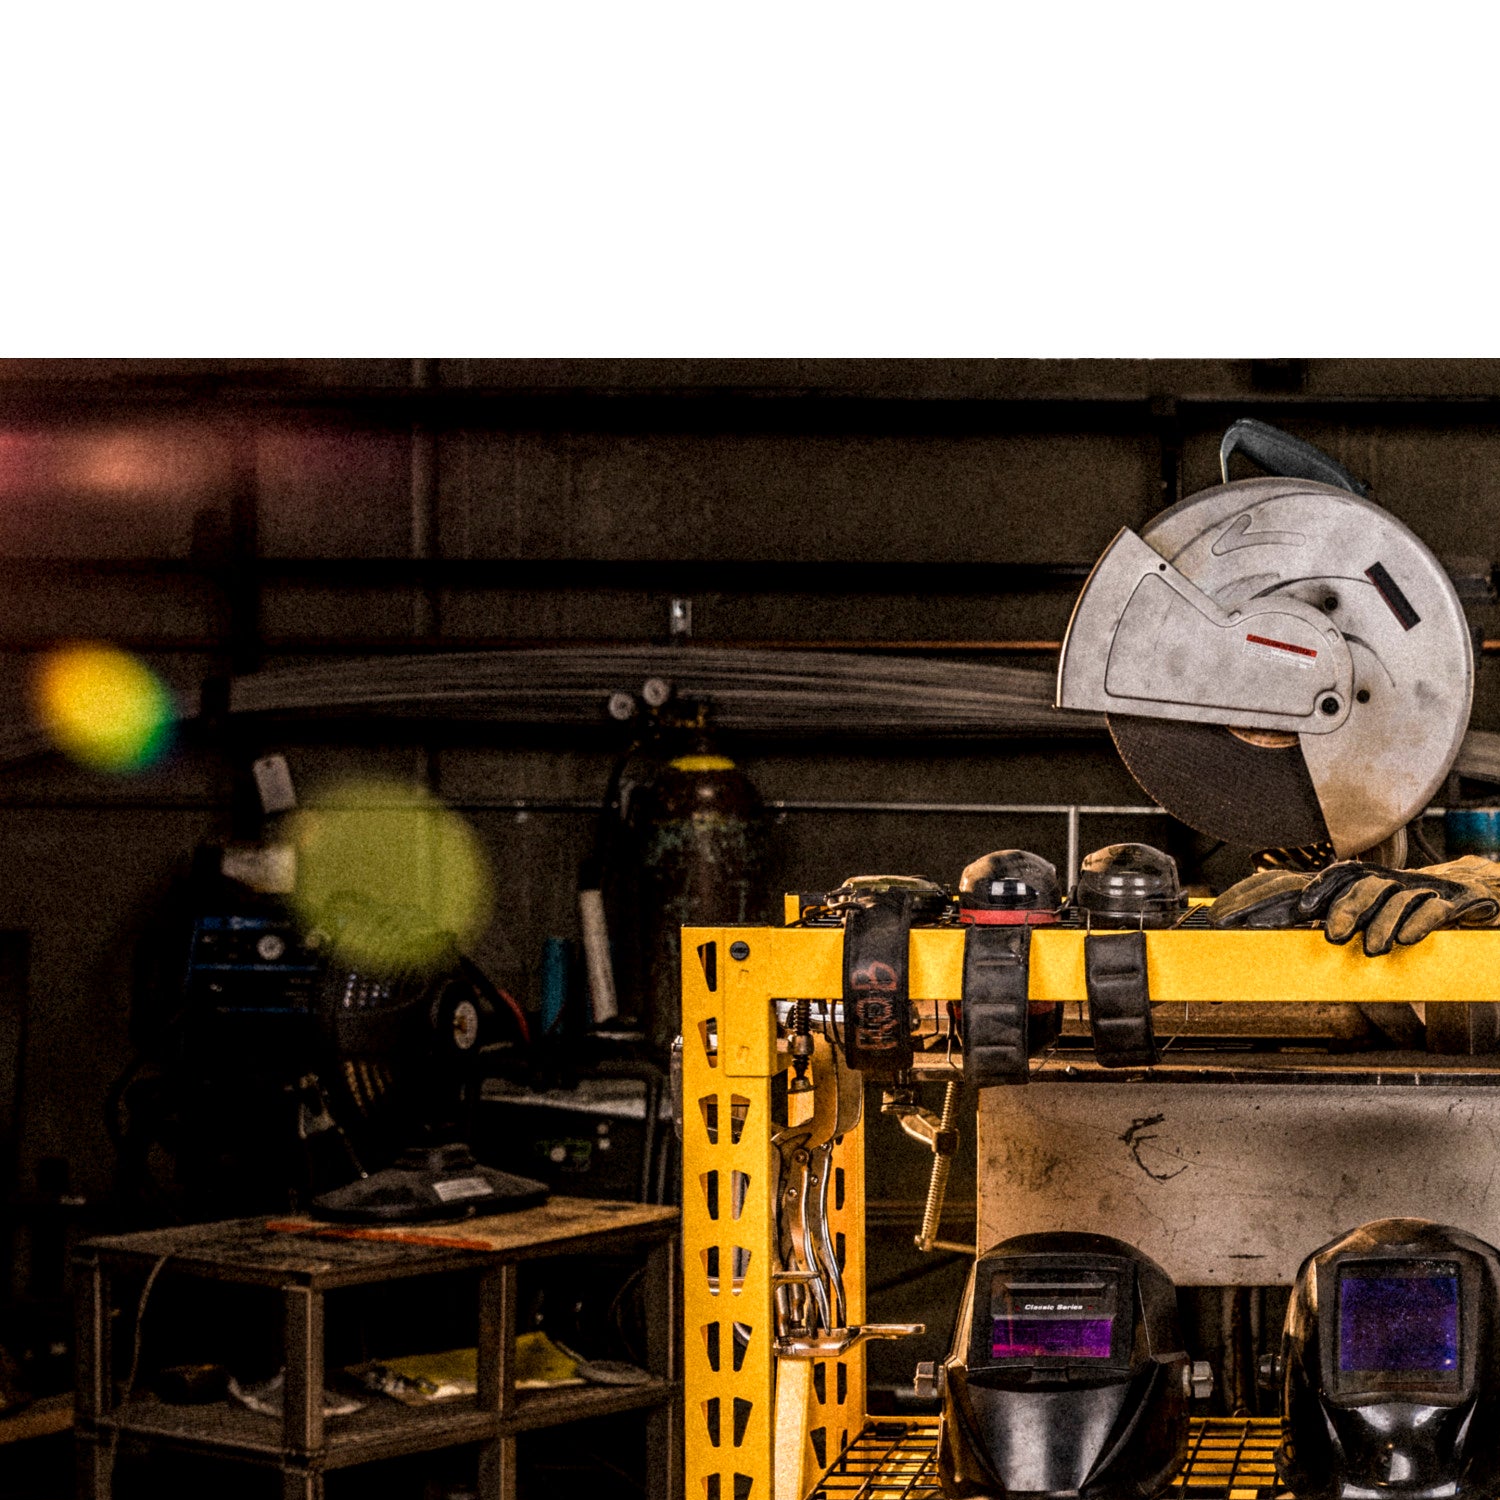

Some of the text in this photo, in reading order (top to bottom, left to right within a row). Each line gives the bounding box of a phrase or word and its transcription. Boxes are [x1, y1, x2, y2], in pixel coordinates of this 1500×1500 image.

[851, 960, 898, 1050] ROB
[1024, 1303, 1084, 1311] Classic Series
